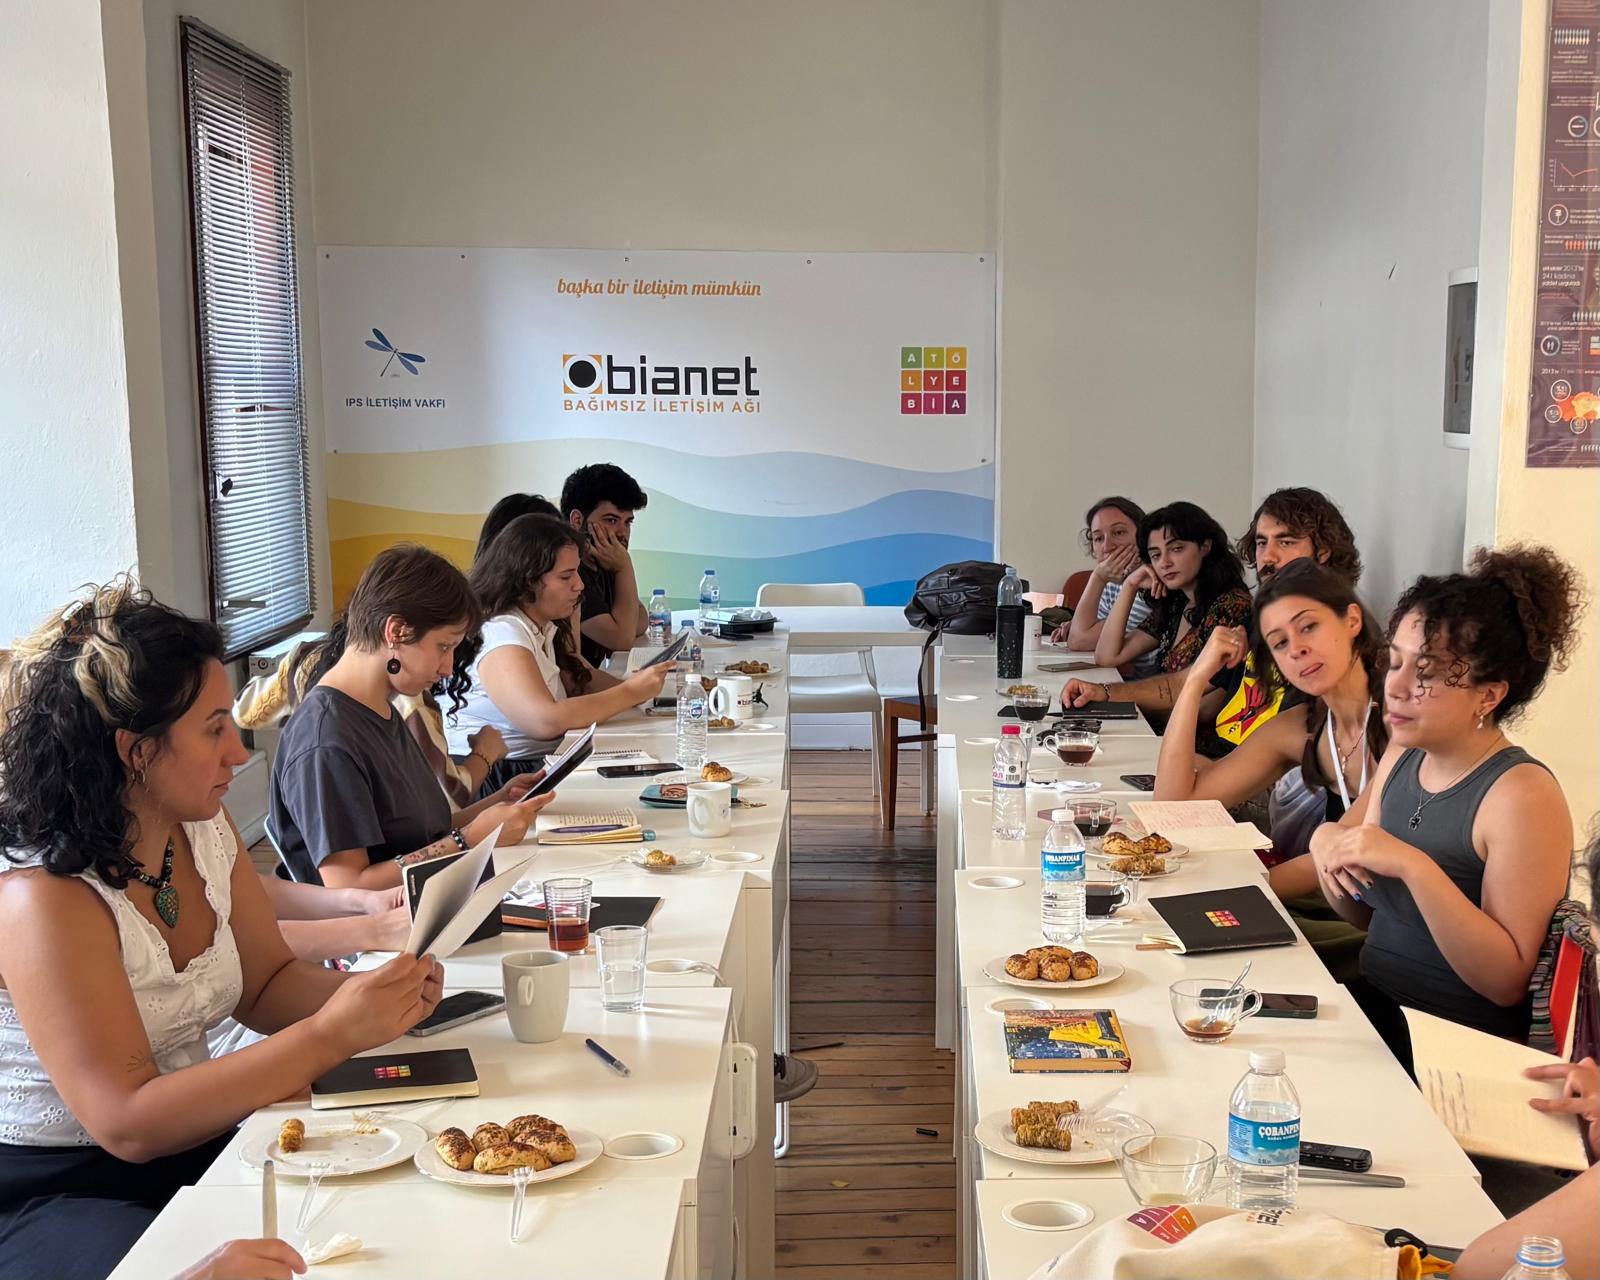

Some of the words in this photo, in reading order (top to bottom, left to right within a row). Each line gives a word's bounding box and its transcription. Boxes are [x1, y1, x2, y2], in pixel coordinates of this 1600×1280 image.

[557, 278, 603, 298] başka
[607, 279, 629, 295] bir
[633, 279, 689, 299] iletişim
[691, 280, 761, 297] mümkün
[606, 354, 760, 396] bianet
[345, 398, 363, 408] IPS
[366, 397, 411, 410] İLETİŞİM
[414, 399, 446, 409] VAKFI
[563, 396, 646, 412] BAĞIMSIZ
[653, 398, 724, 414] İLETİŞİM
[731, 399, 760, 413] AĞI
[1258, 1124, 1299, 1139] ÇOBANPIN
